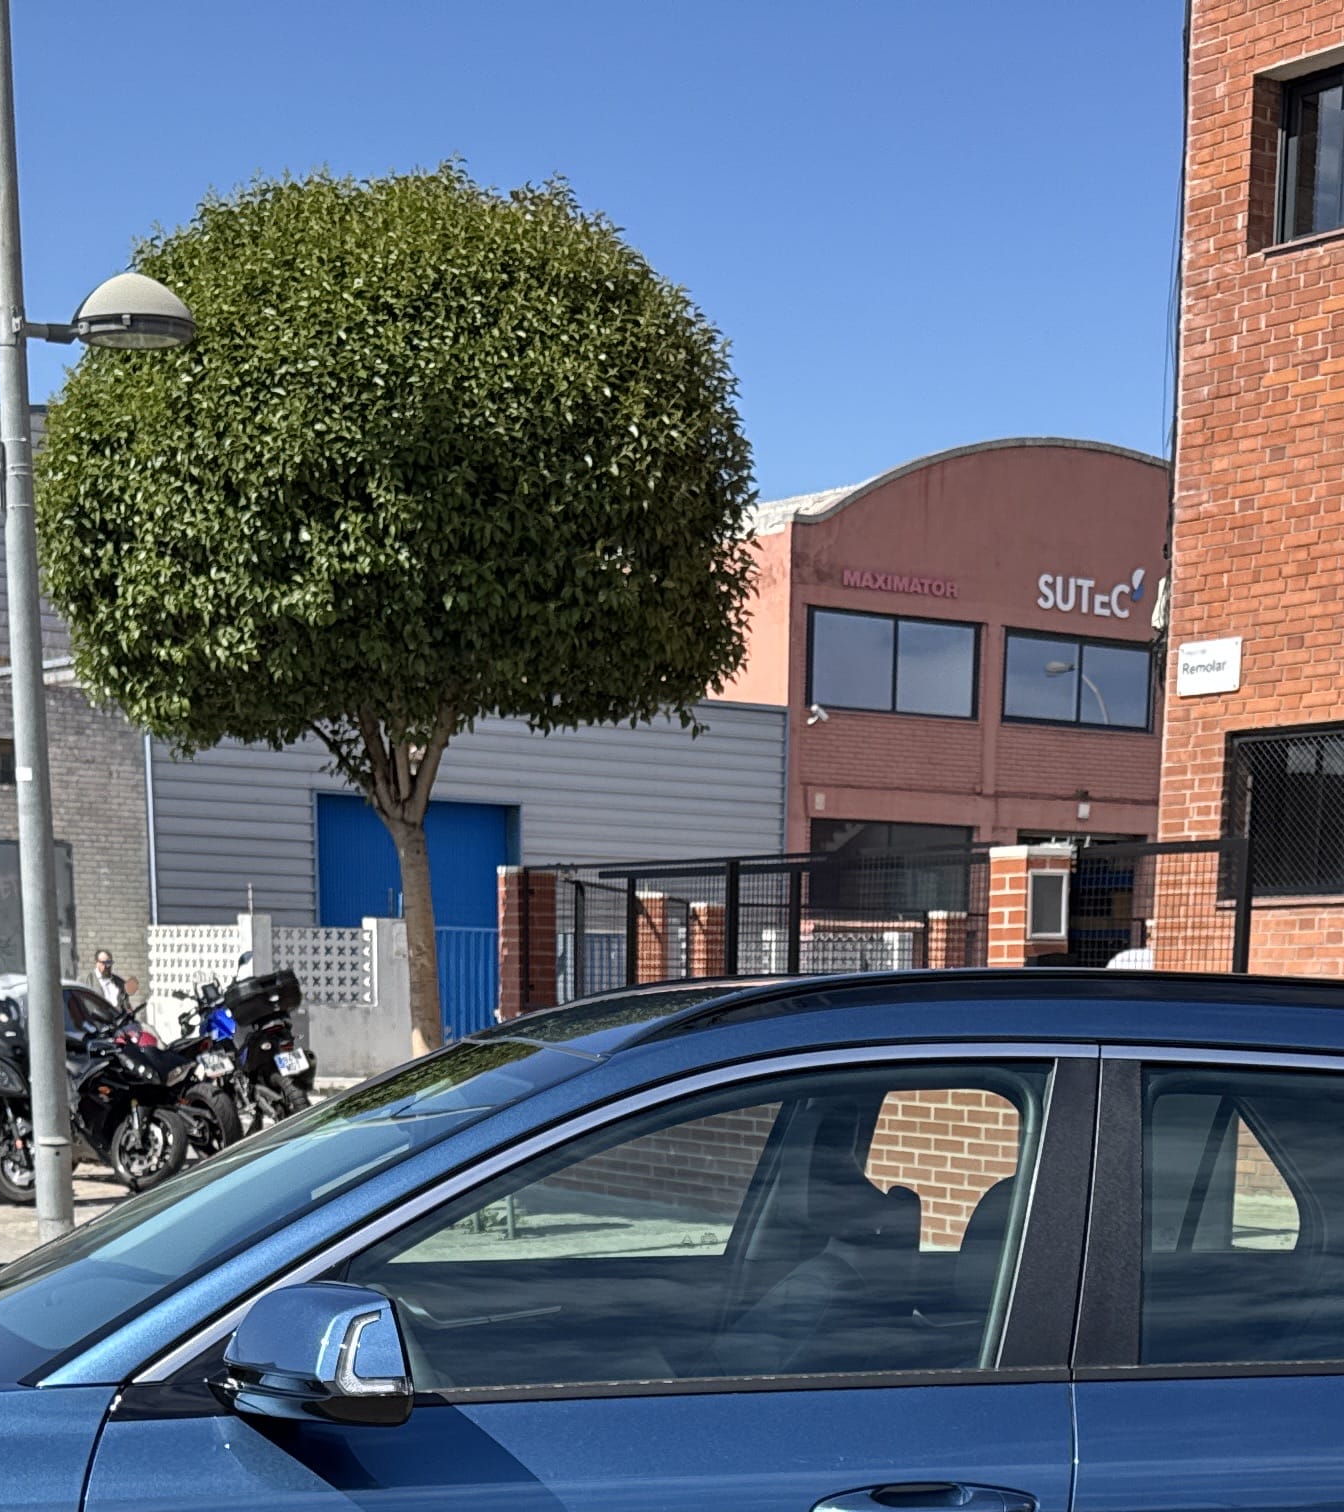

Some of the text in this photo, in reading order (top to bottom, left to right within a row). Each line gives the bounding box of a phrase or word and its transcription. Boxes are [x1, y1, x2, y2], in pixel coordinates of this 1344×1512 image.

[843, 570, 958, 598] MAXIMATOR
[1037, 573, 1130, 618] SUTEC
[1182, 659, 1227, 675] Remolar
